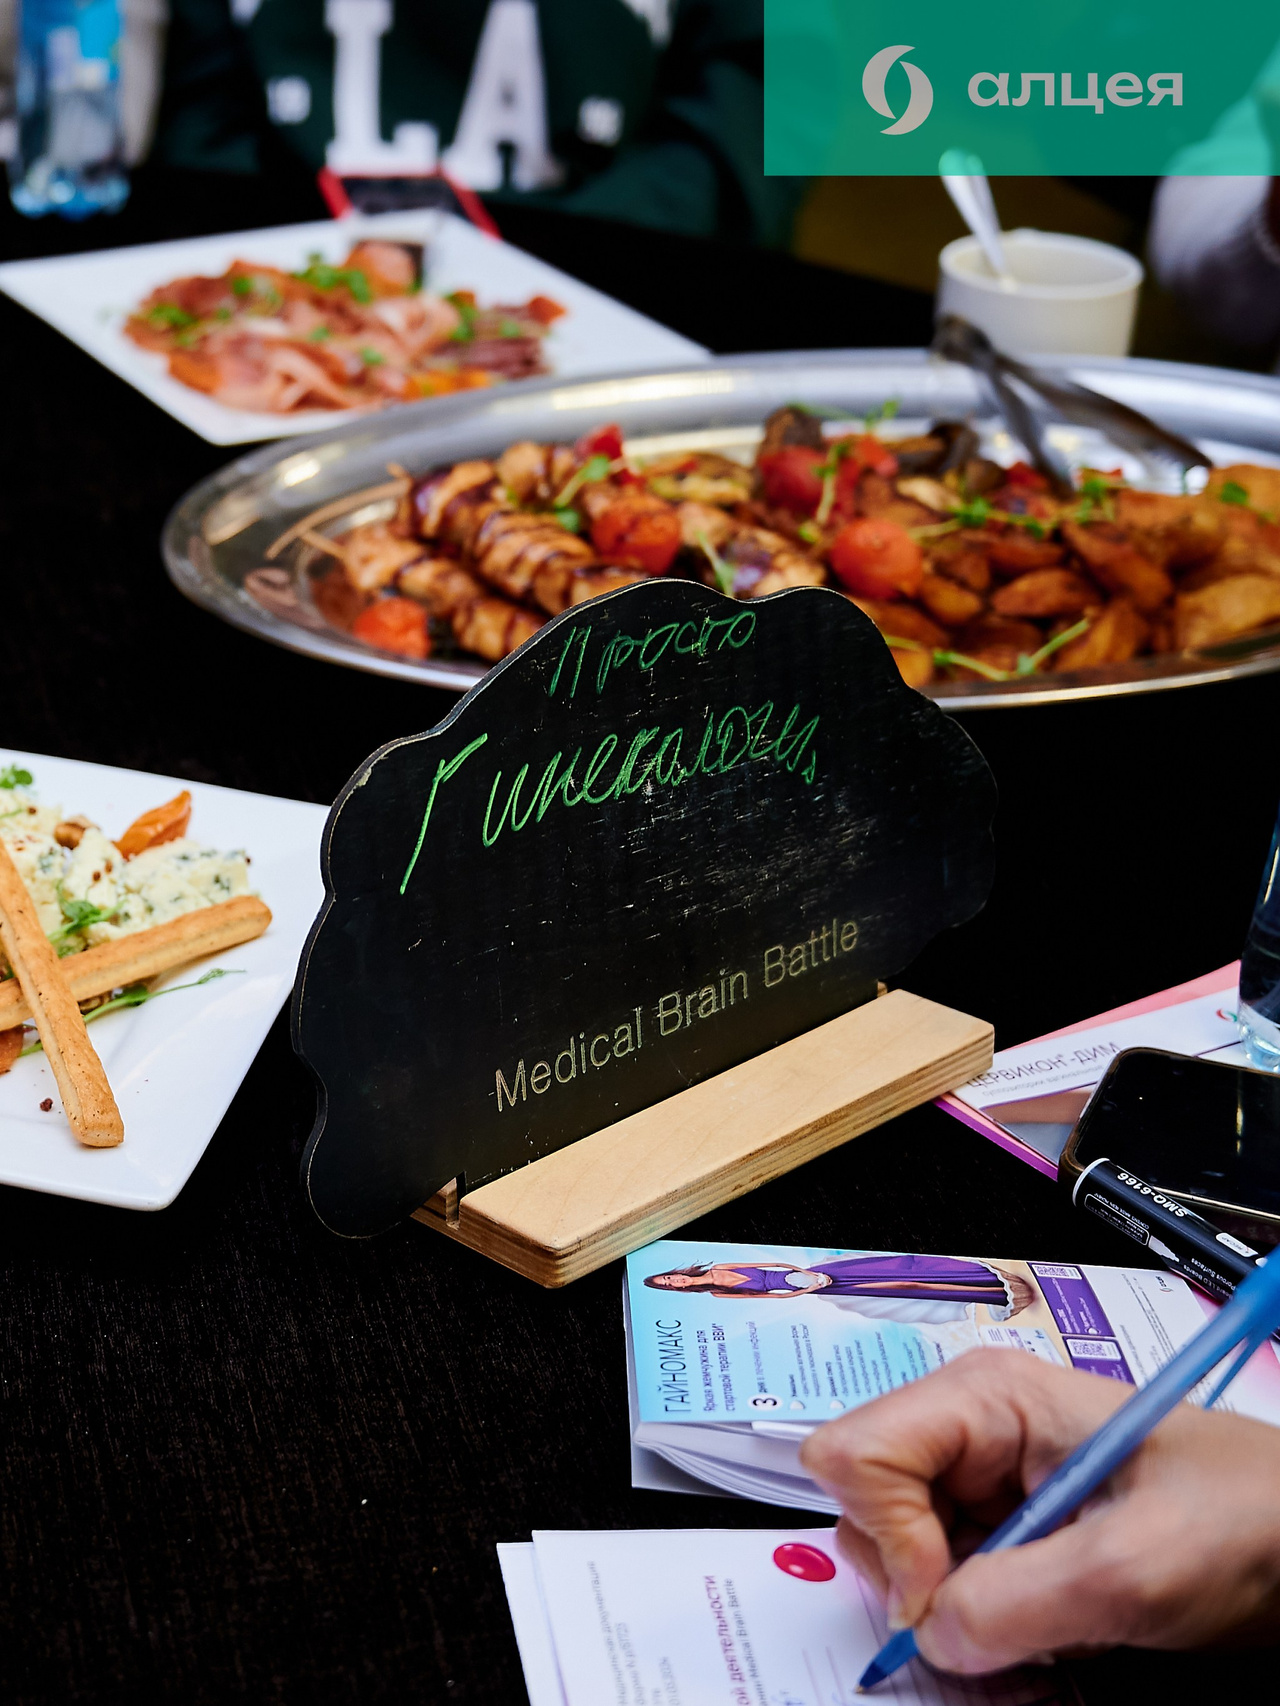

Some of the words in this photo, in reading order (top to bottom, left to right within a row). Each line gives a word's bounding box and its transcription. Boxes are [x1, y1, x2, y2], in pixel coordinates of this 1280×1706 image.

[495, 1006, 643, 1112] Medical
[657, 969, 749, 1036] Brain
[763, 918, 859, 988] Battle
[1117, 1171, 1188, 1218] SMQ-6166
[655, 1319, 691, 1412] ГАЙНОМАКС
[752, 1397, 778, 1407] 3
[703, 1574, 746, 1683] деятельности
